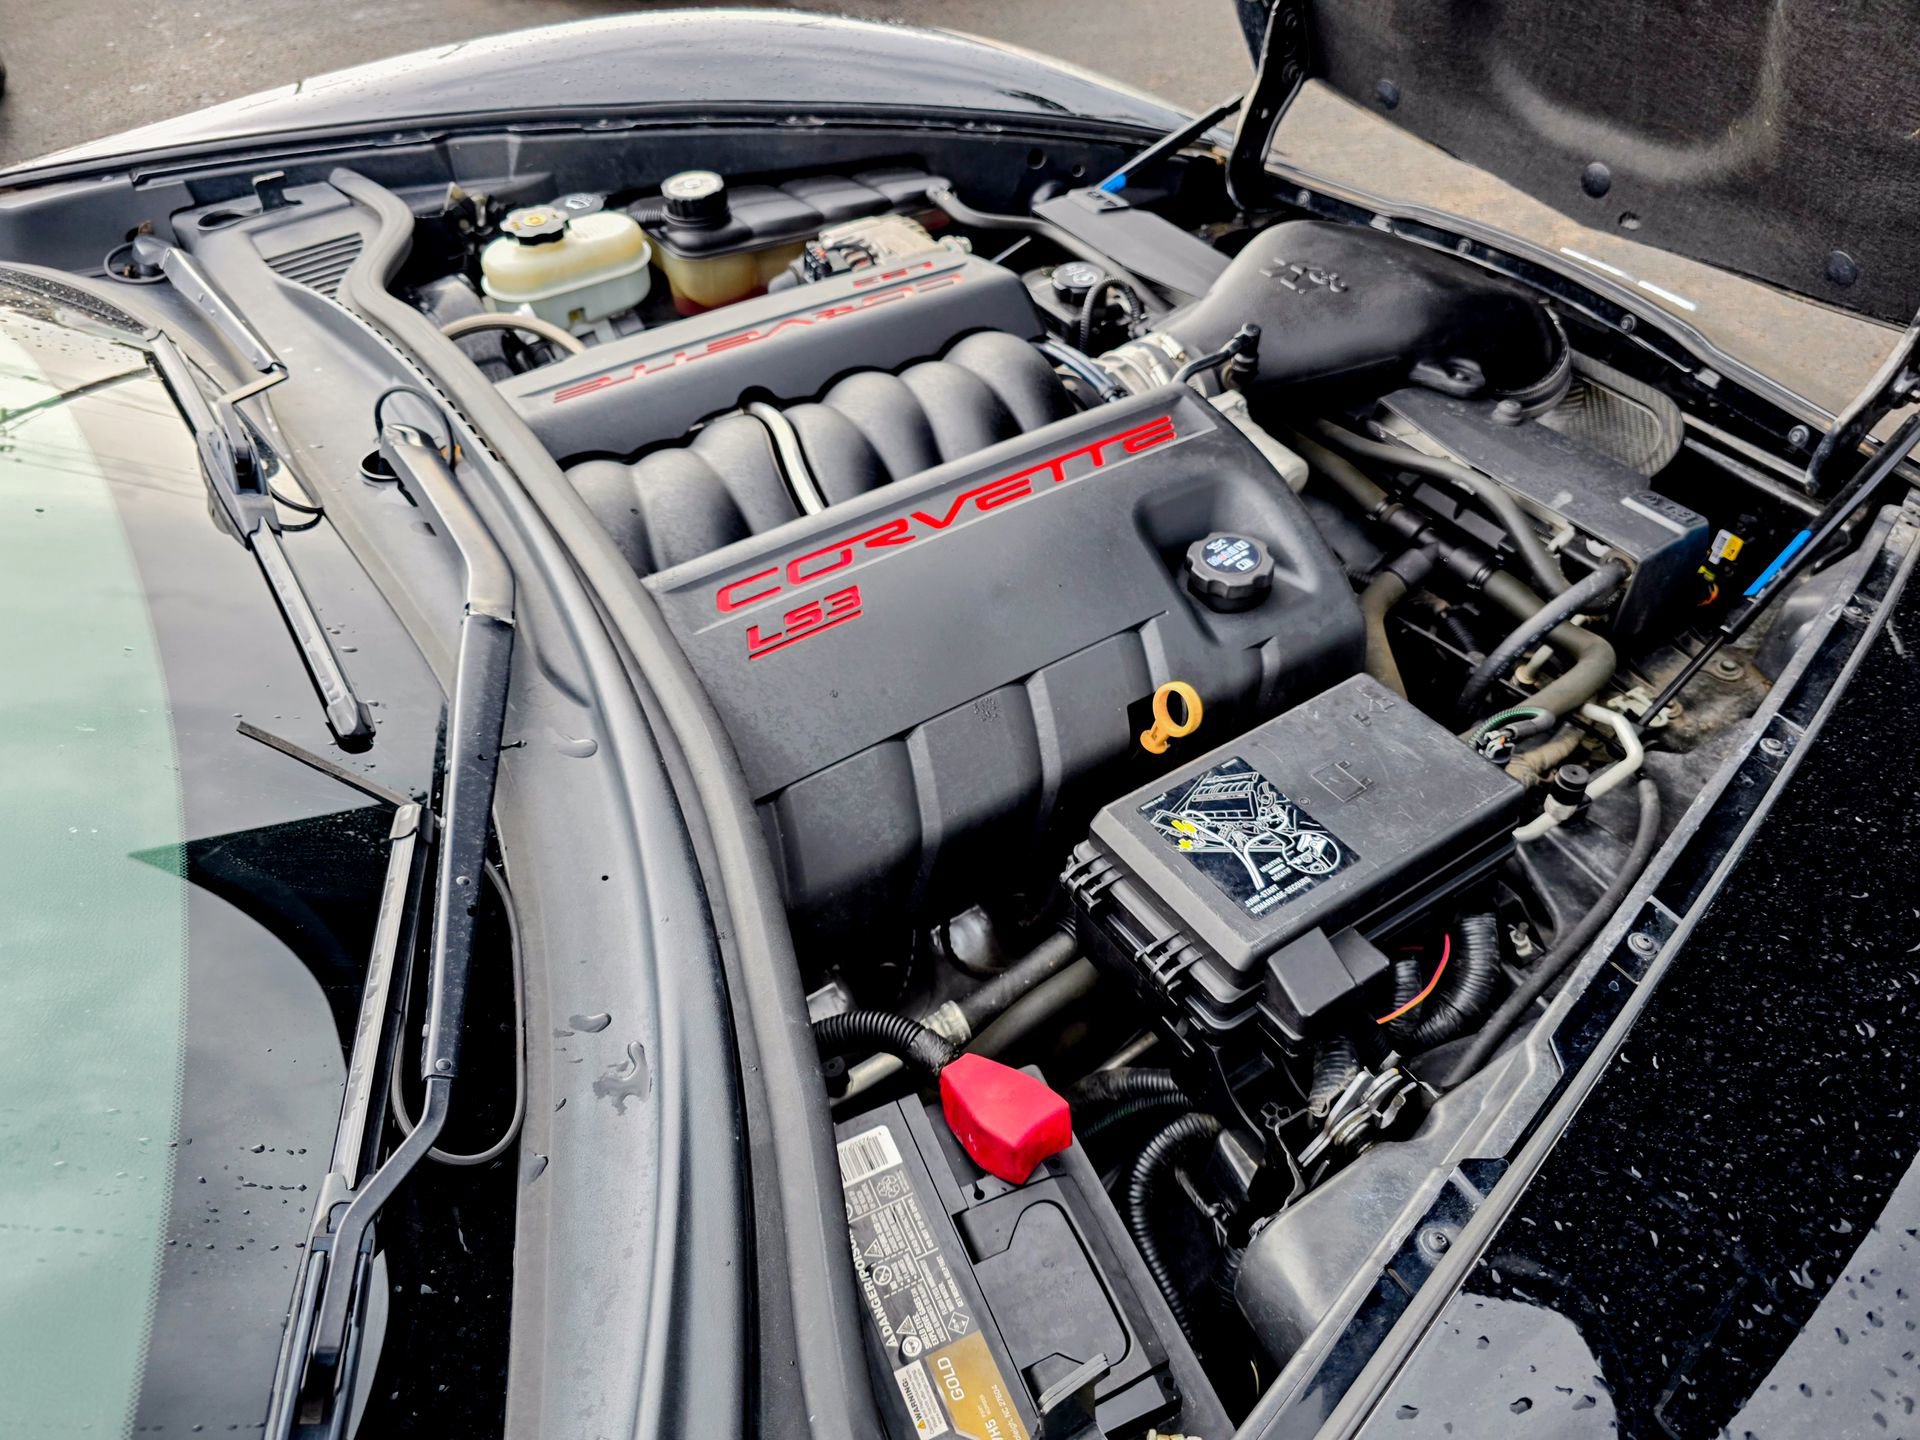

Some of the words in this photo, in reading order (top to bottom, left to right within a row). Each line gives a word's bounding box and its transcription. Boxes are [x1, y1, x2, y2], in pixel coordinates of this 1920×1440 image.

[553, 273, 963, 404] CORVETTE
[716, 415, 1176, 614] CORVETTE
[746, 584, 863, 652] LS3
[896, 1258, 911, 1280] FLAMES
[912, 1295, 927, 1316] GASES
[917, 1327, 933, 1350] SHIELD
[919, 1313, 940, 1346] EXPLOSIVE
[900, 1377, 923, 1422] WARNING:
[934, 1354, 967, 1402] GOLD
